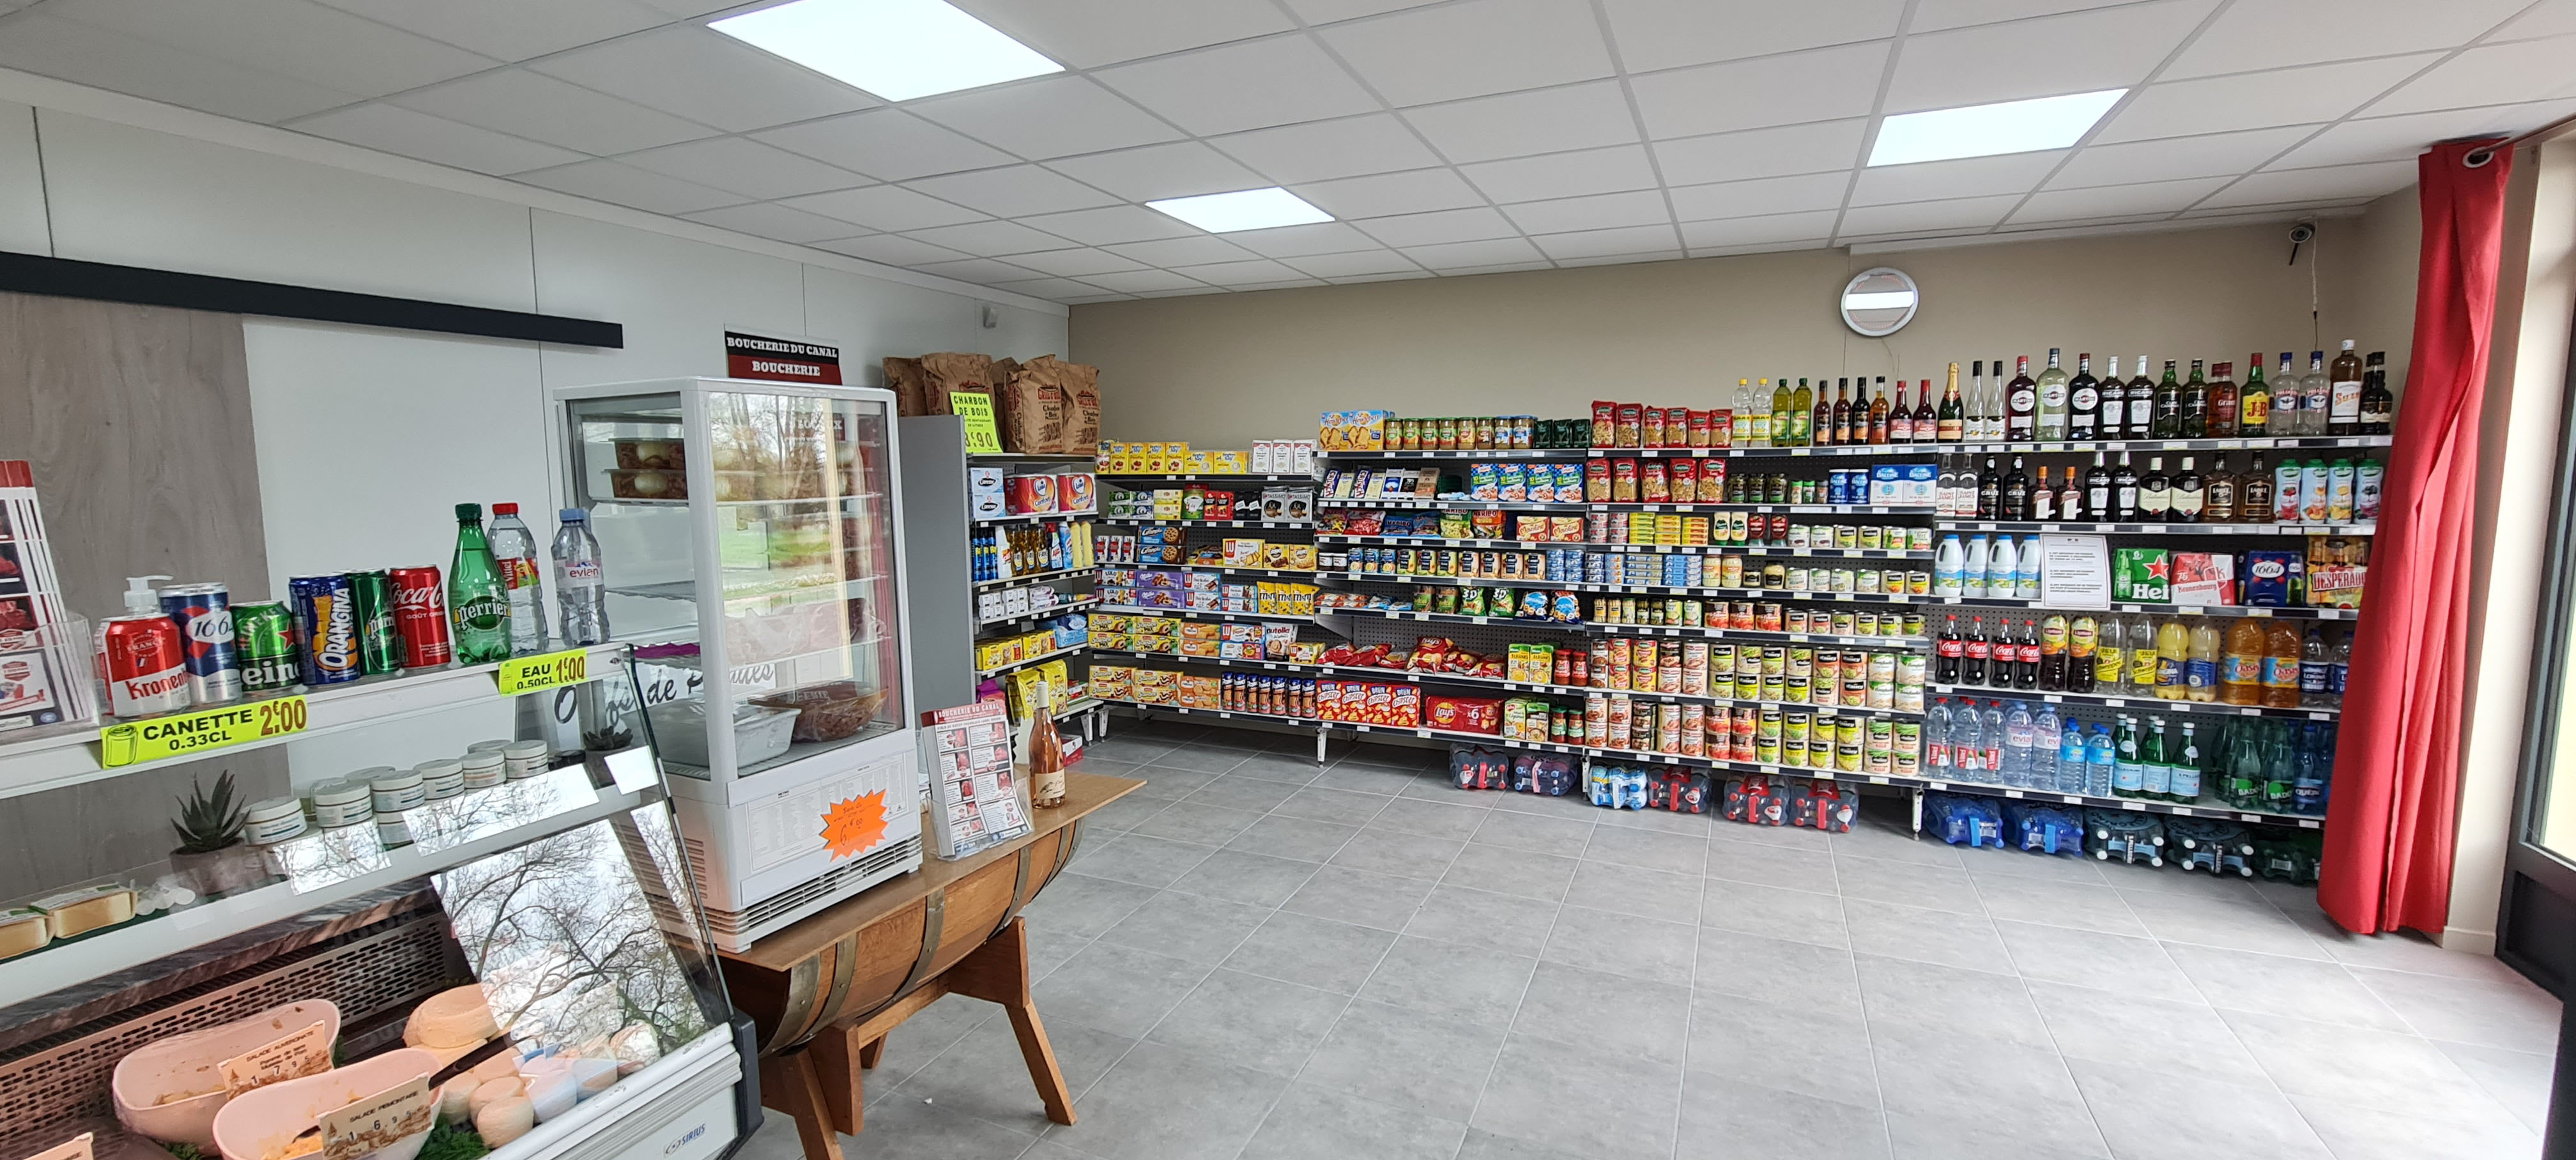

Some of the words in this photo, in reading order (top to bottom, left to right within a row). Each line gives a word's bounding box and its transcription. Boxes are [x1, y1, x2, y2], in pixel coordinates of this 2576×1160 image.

[726, 337, 789, 353] BOUCHERIE
[791, 344, 804, 354] DU
[806, 346, 837, 358] CANAL
[752, 360, 820, 376] BOUCHERIE
[954, 395, 988, 405] CHARBON
[959, 407, 968, 415] DE
[971, 408, 988, 416] BOIS
[569, 567, 599, 577] evian
[2255, 564, 2281, 574] 1664
[319, 588, 352, 668] ORANGINA
[522, 664, 551, 678] EAU
[517, 676, 555, 690] 0.50CL
[647, 668, 678, 704] de
[143, 709, 253, 740] CANETTE
[169, 730, 232, 751] 0.33CL
[246, 1047, 271, 1062] SALADE
[349, 1108, 376, 1123] SALADE
[682, 1123, 705, 1145] SIRIUS
